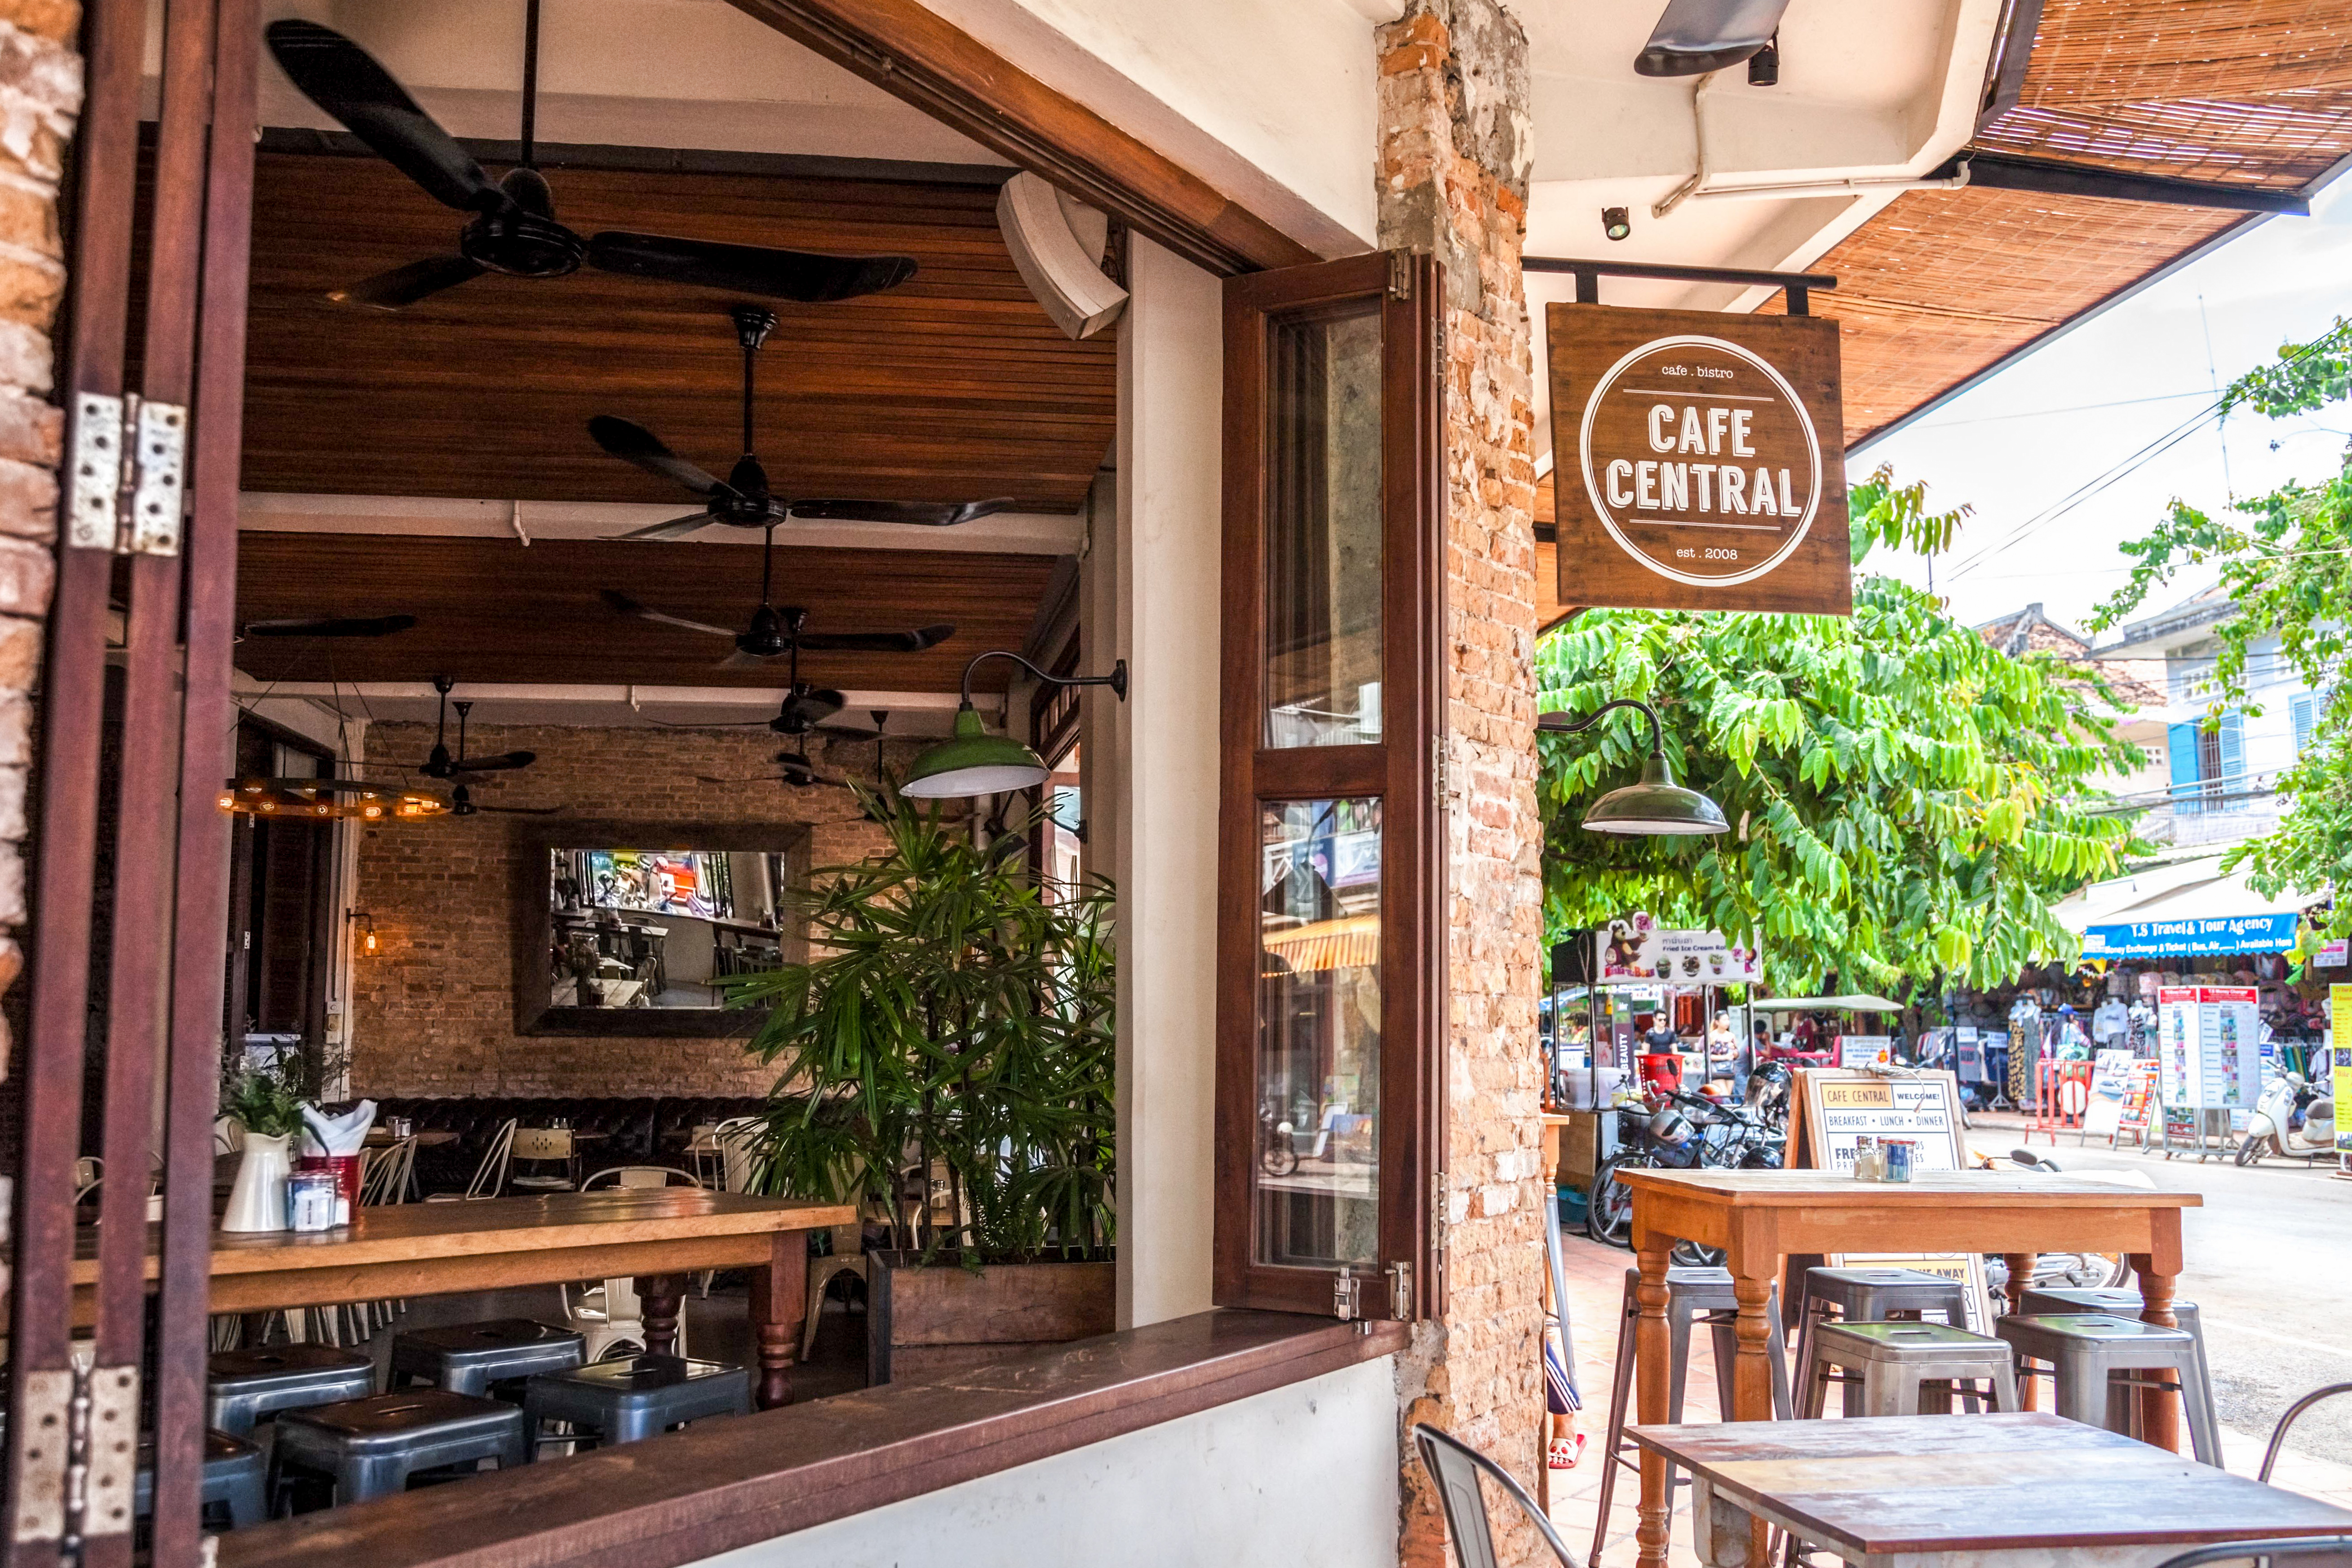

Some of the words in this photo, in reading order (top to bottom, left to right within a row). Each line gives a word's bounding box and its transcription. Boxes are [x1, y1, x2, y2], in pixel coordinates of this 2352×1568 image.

[1662, 365, 1688, 376] cafe
[1696, 366, 1733, 379] bistro
[1648, 404, 1755, 457] CAFE
[1606, 459, 1802, 517] CENTRAL
[1705, 548, 1738, 560] 2008
[2152, 921, 2186, 937] Travel
[2187, 921, 2196, 935] &
[2198, 920, 2227, 934] Tour
[2228, 917, 2273, 935] Agency
[2126, 944, 2157, 955] Exchange
[2165, 943, 2187, 951] Ticket
[2240, 939, 2273, 949] Available
[2275, 937, 2293, 947] Here
[1619, 1033, 1629, 1070] BEAUTY
[1827, 1090, 1847, 1102] CAFE
[1852, 1090, 1889, 1102] CENTRAL
[1829, 1116, 1867, 1126] BREAKFAST
[1880, 1116, 1904, 1126] LUNCH
[1916, 1116, 1944, 1126] DINNER
[1936, 1268, 1965, 1279] AWAY
